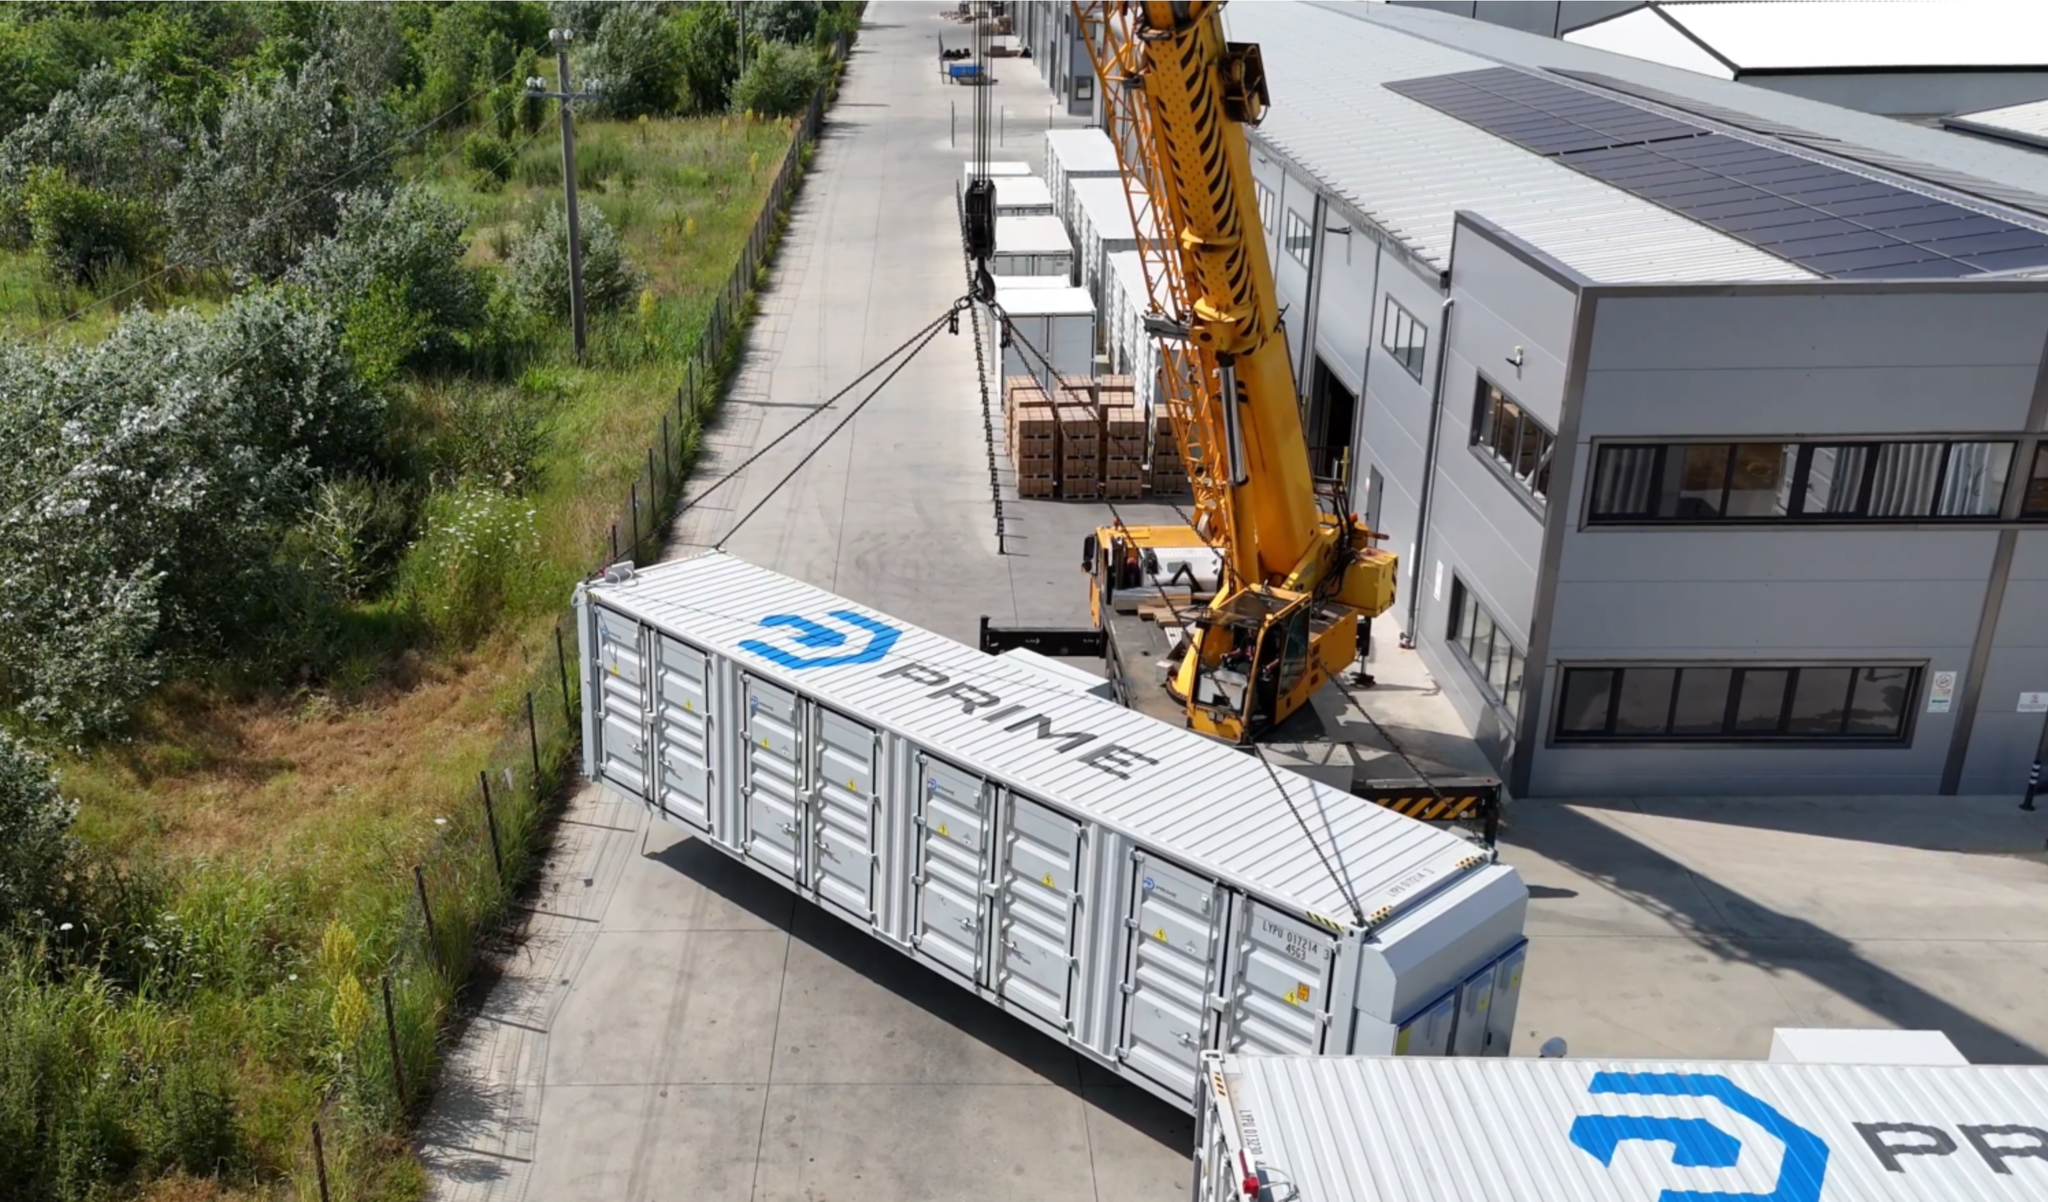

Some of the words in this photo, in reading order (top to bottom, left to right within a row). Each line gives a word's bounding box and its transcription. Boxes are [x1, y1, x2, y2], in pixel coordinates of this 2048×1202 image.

[877, 662, 1160, 781] PRIME
[1262, 920, 1284, 939] LYPU
[1286, 932, 1318, 954] 017214
[1324, 949, 1330, 960] 3
[1239, 1109, 1256, 1127] LYPU
